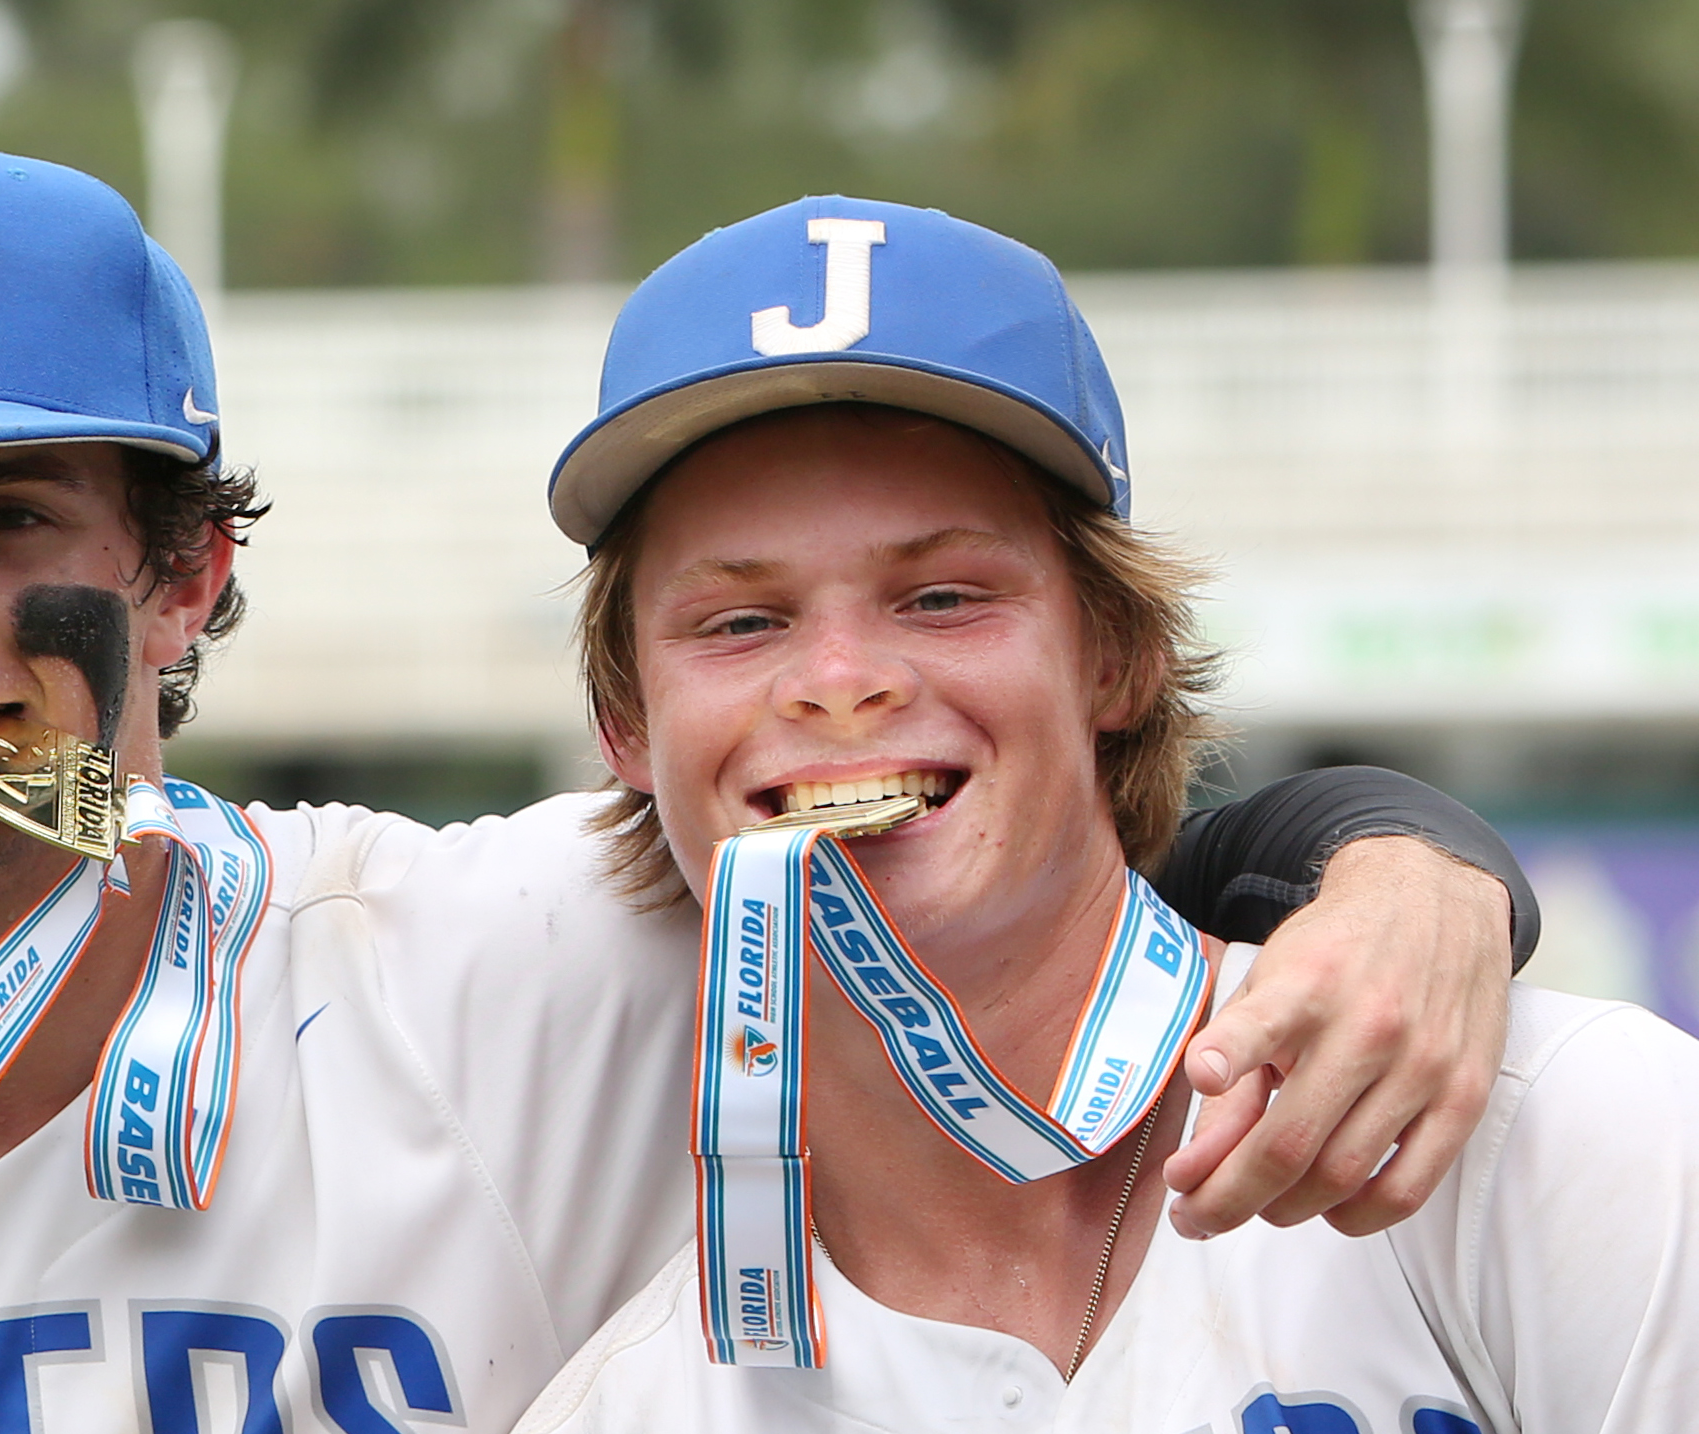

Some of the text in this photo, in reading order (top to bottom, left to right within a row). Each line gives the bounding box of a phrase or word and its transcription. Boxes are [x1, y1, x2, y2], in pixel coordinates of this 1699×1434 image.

[750, 218, 886, 358] J
[738, 898, 765, 1020] FLORIDA
[809, 852, 990, 1121] BASEBALL
[117, 1057, 162, 1207] BASE
